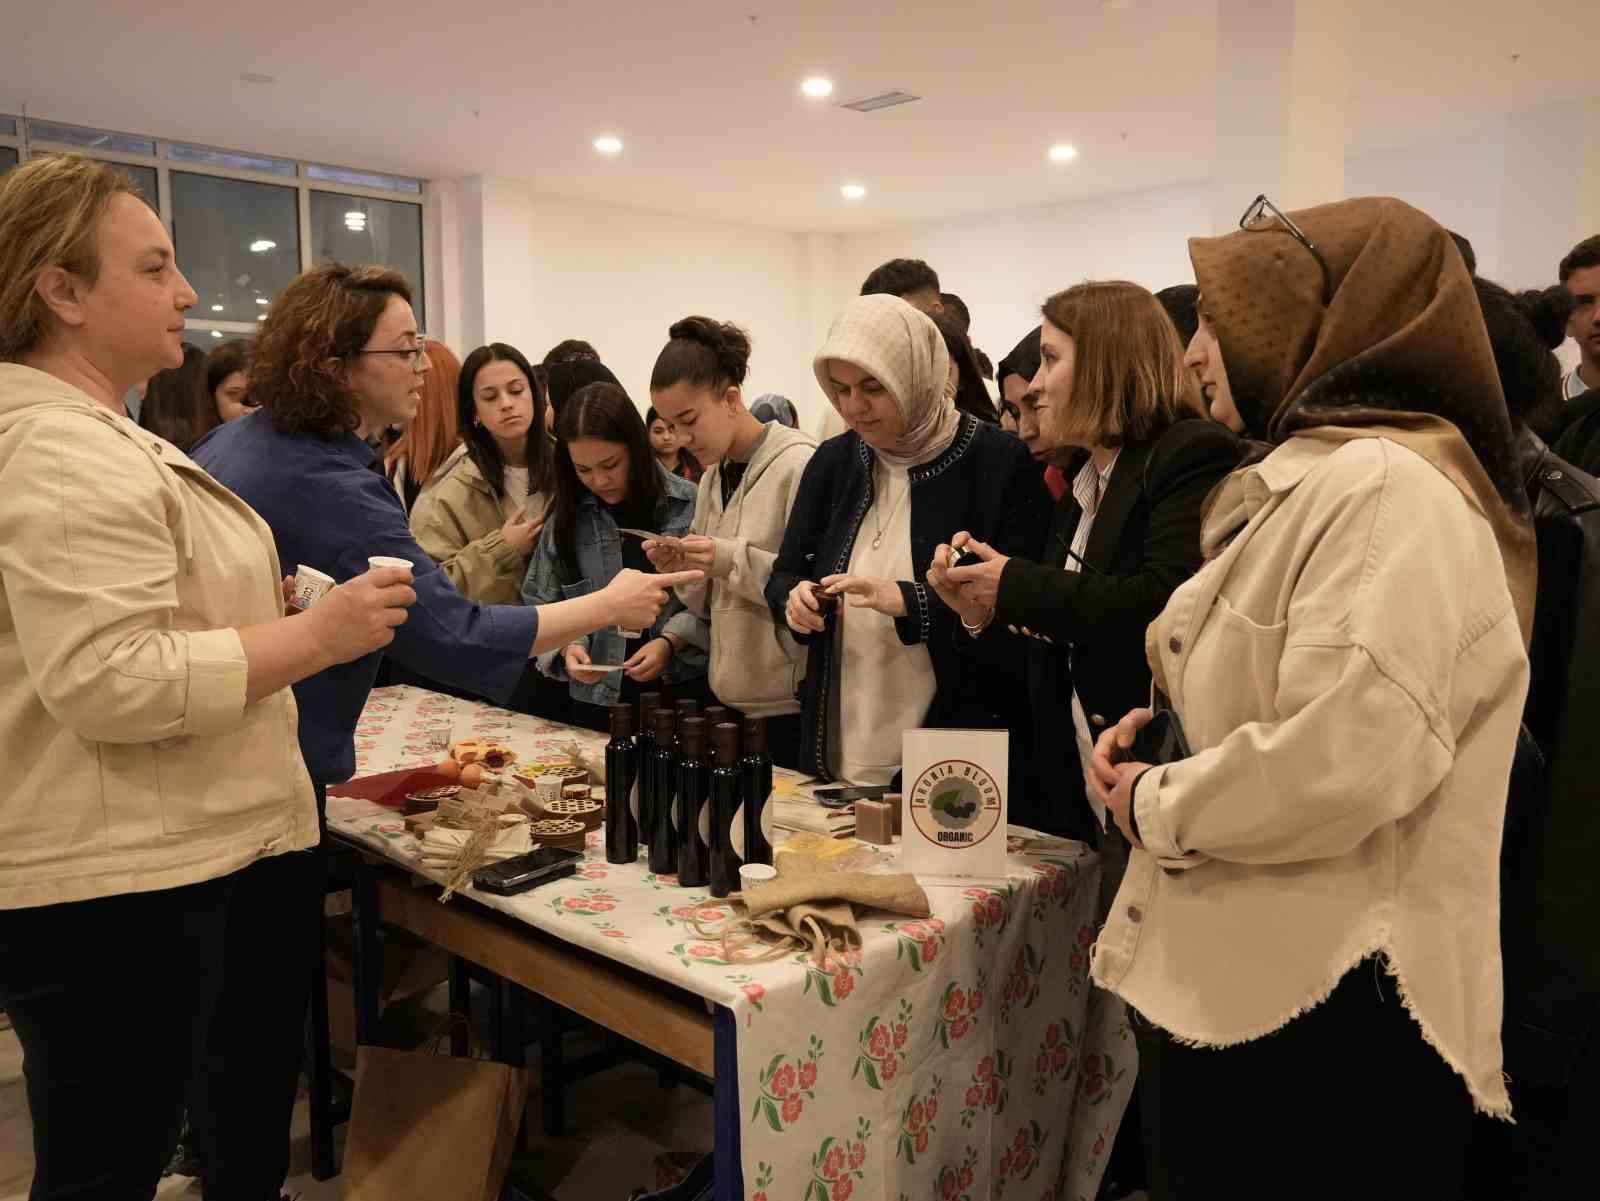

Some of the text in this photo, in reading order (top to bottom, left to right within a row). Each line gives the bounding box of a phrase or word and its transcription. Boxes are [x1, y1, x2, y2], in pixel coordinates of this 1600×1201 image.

[915, 765, 996, 806] ARONIA BLOOM
[937, 831, 974, 842] ORGANIC
